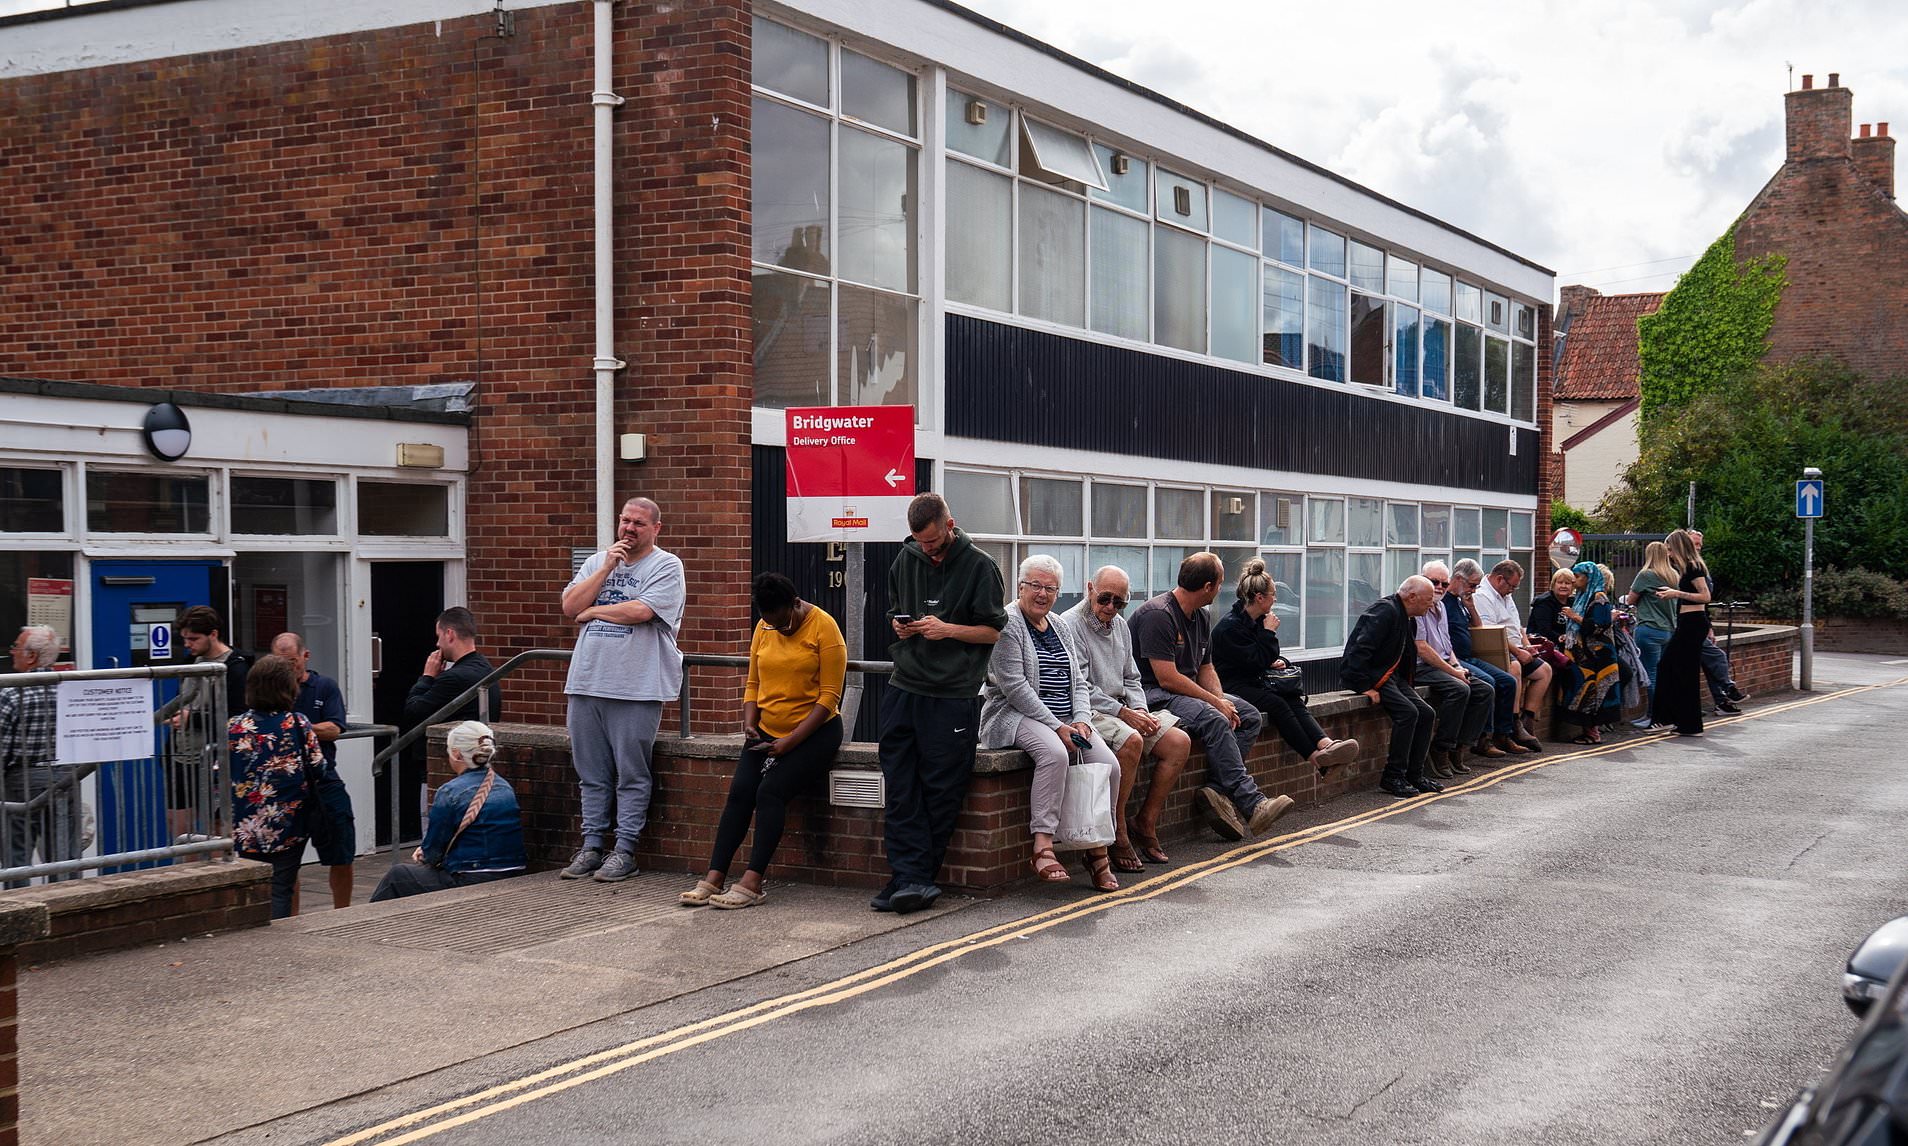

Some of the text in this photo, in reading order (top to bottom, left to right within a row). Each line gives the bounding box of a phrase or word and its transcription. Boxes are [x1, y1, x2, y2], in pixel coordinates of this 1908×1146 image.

[793, 415, 874, 431] Bridgwater
[793, 435, 856, 447] Delivery Office
[833, 519, 851, 527] Royal
[828, 571, 847, 588] 19
